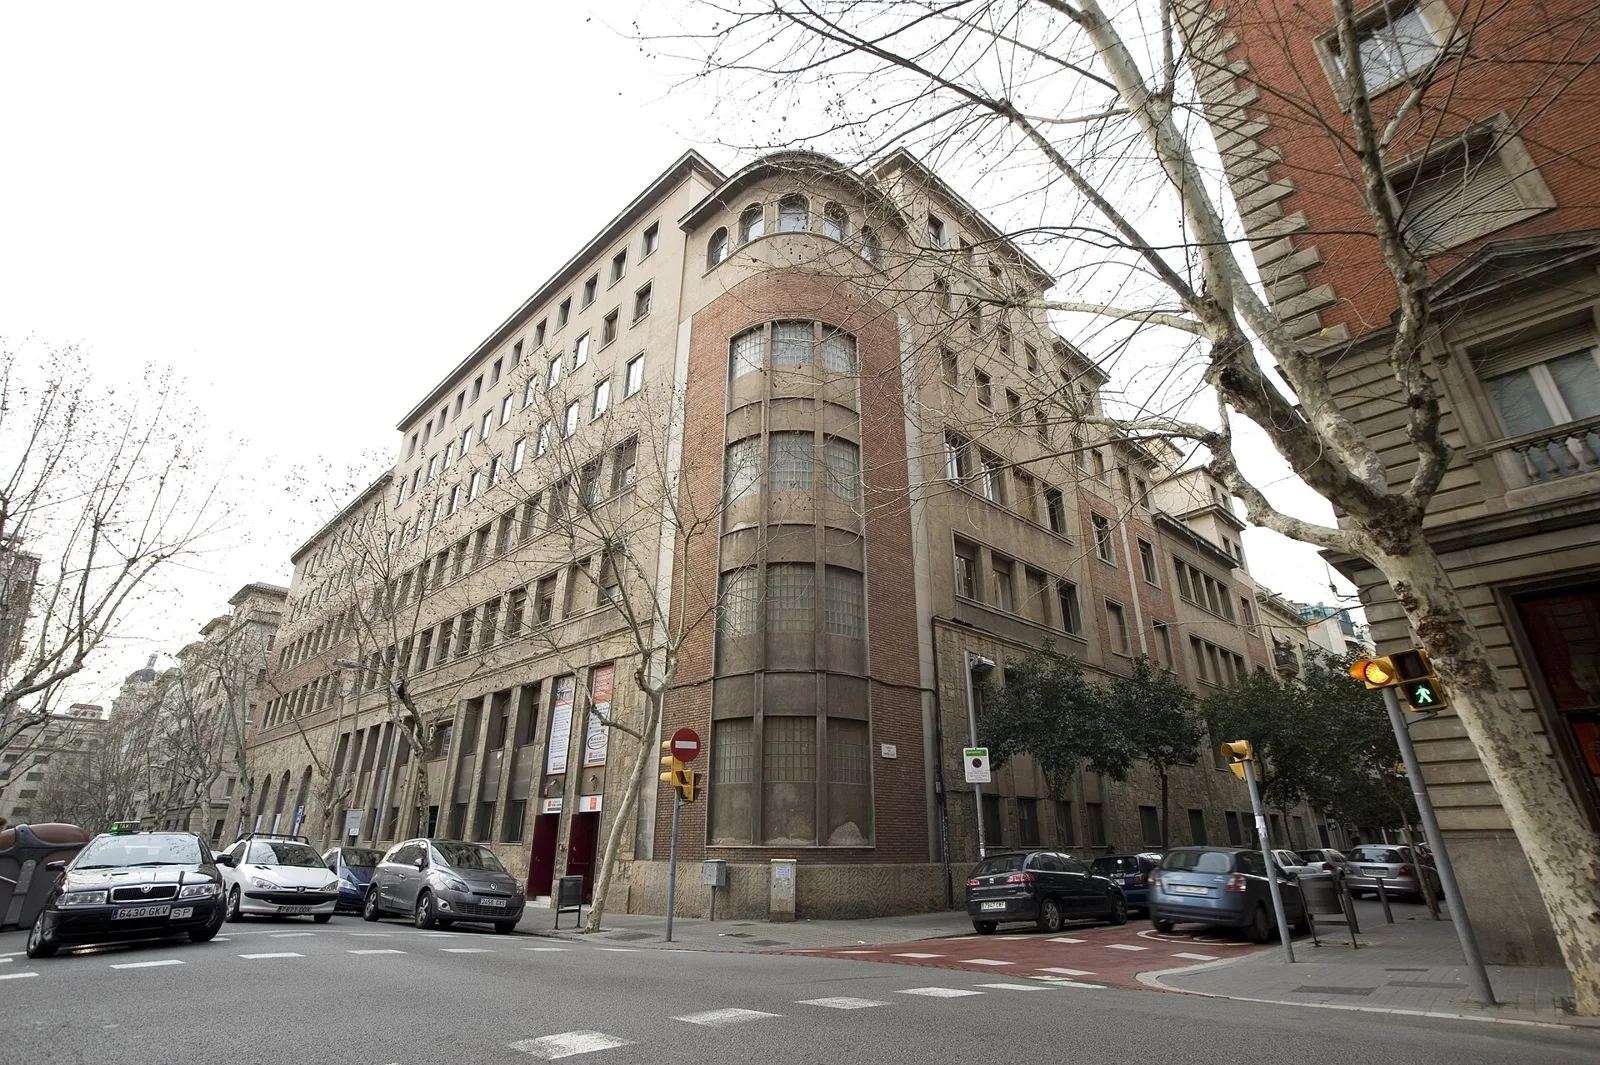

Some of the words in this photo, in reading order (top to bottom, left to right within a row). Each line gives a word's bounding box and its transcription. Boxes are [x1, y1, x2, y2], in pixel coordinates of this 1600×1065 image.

[120, 908, 146, 918] 6430
[148, 906, 169, 915] GKV
[173, 908, 191, 918] SP
